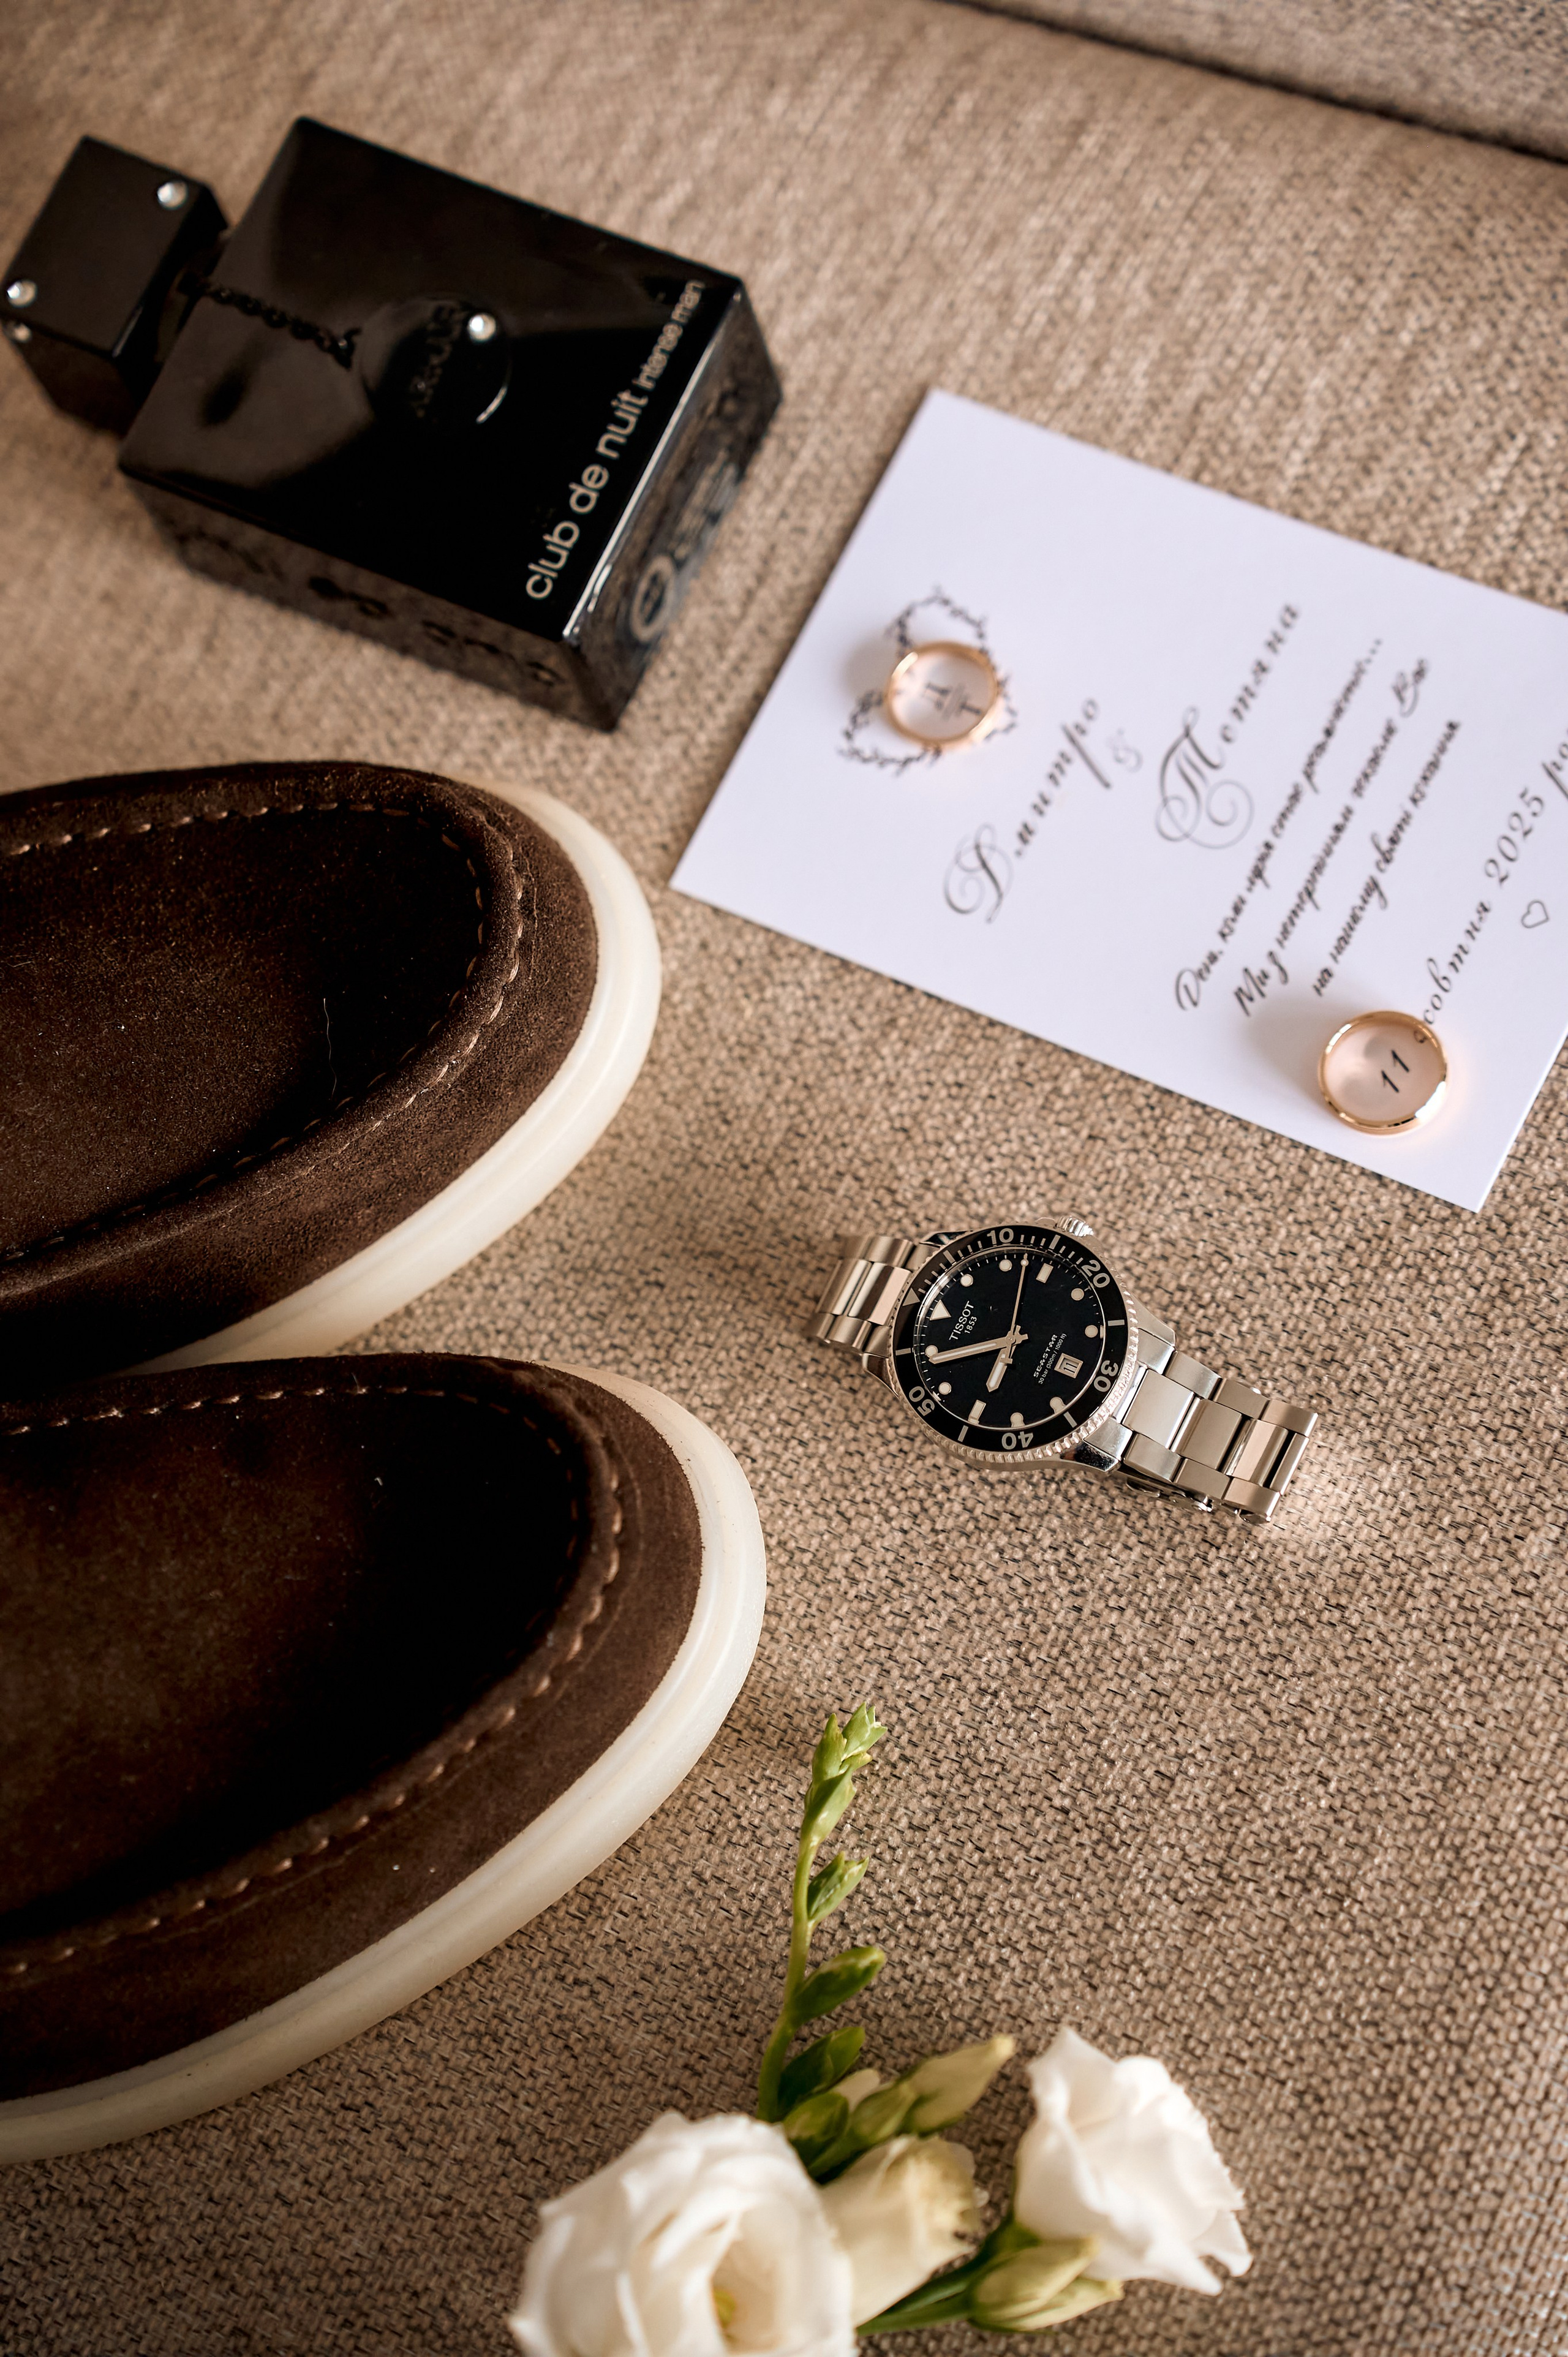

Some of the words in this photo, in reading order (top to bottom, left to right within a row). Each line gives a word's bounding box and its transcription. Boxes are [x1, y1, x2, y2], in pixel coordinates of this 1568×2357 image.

[526, 521, 580, 600] club
[569, 464, 609, 515] de
[595, 389, 649, 459] nuit
[631, 320, 684, 390] intense
[671, 280, 706, 325] man
[1392, 658, 1428, 718] Вас
[1155, 603, 1300, 849] Тетяна
[943, 700, 1112, 924] Дмитро
[1217, 894, 1248, 944] коли
[1246, 840, 1274, 892] мрія
[1275, 804, 1354, 949] нетерпінням
[1313, 967, 1334, 998] на
[1329, 875, 1388, 965] нашому
[1370, 804, 1412, 874] святі
[1380, 1049, 1411, 1094] 11
[1484, 787, 1545, 888] 2025
[1267, 950, 1289, 986] з
[1234, 967, 1270, 1017] Ми
[987, 1228, 1014, 1245] 10
[1081, 1260, 1110, 1288] 20
[949, 1300, 974, 1340] TISSOT
[964, 1316, 977, 1333] 1853
[1033, 1334, 1058, 1378] SEASTAR
[1046, 1354, 1056, 1369] (300m
[1055, 1339, 1063, 1350] 1000
[1063, 1362, 1078, 1373] 11
[1093, 1360, 1119, 1392] 30
[909, 1386, 935, 1416] 50
[1001, 1431, 1033, 1450] 40
